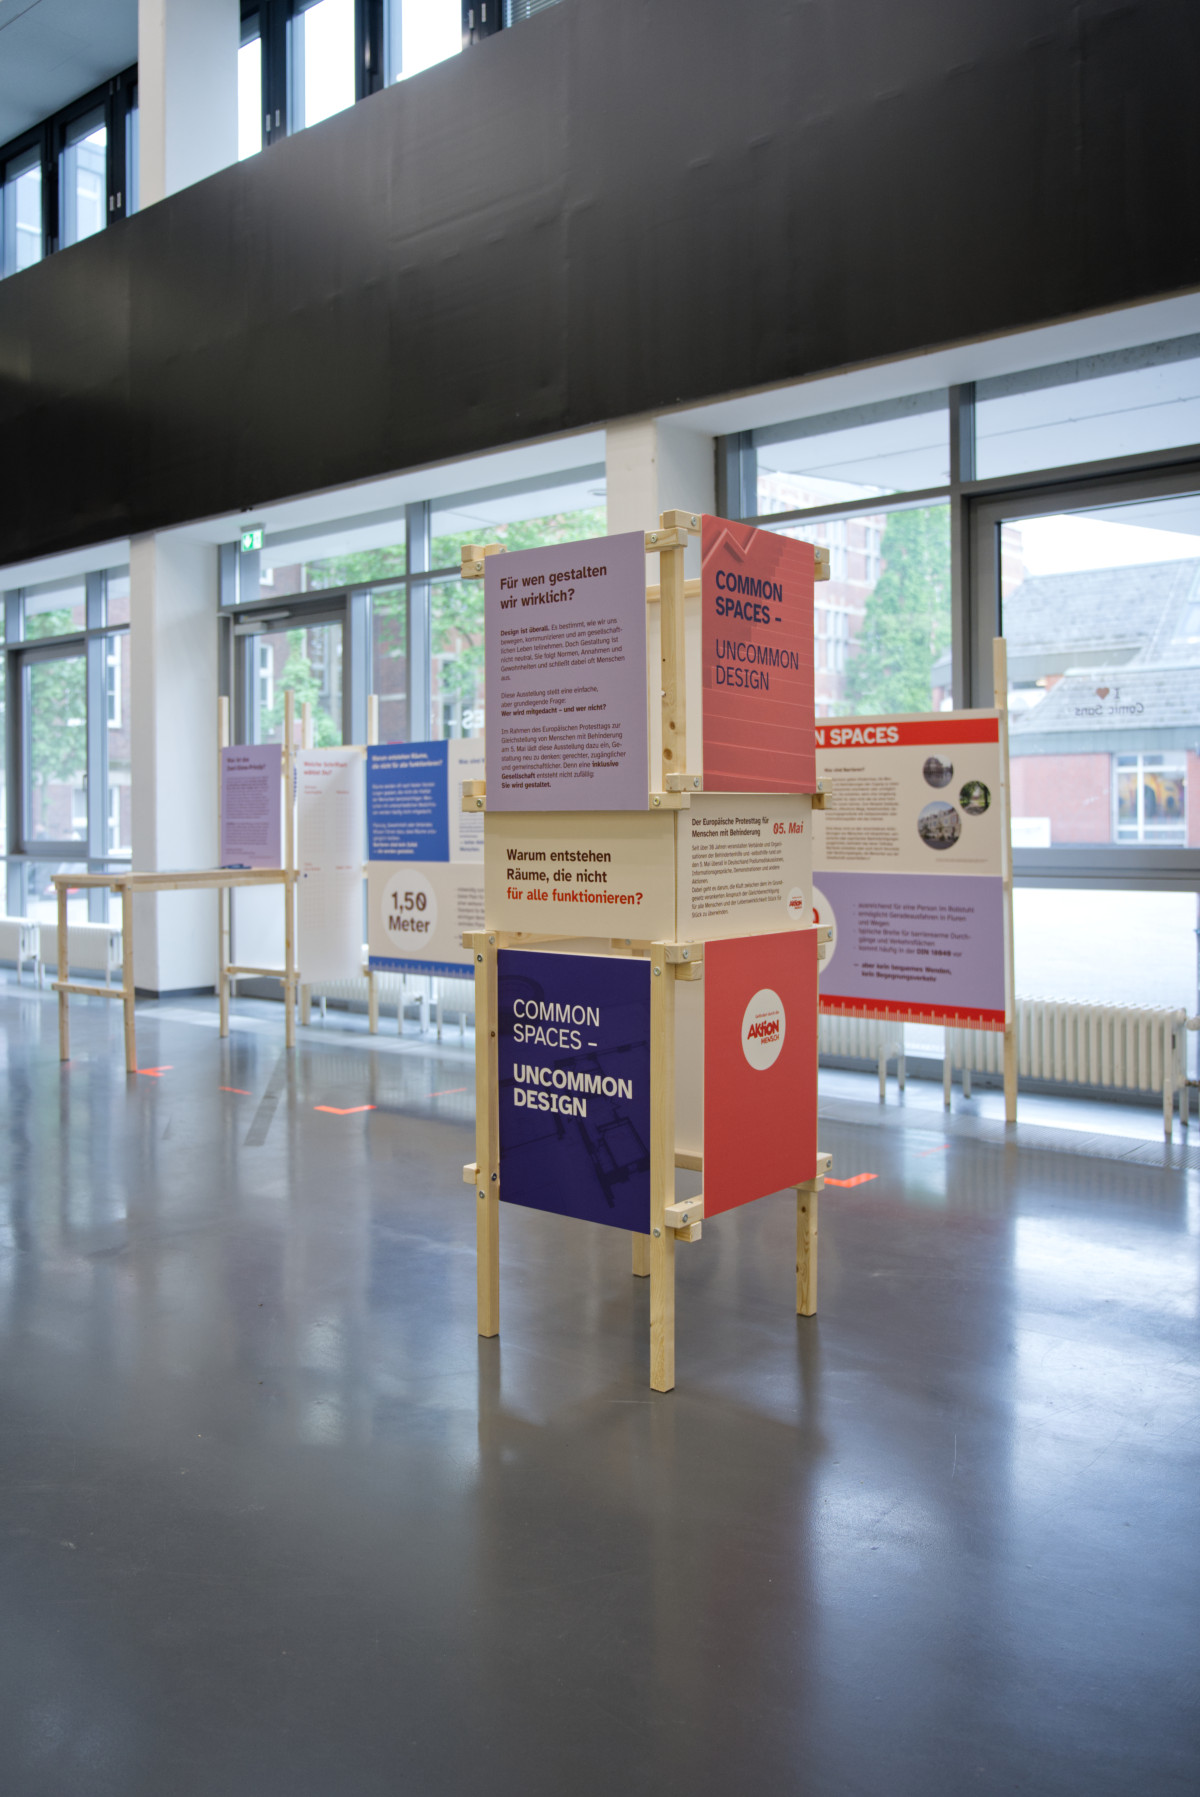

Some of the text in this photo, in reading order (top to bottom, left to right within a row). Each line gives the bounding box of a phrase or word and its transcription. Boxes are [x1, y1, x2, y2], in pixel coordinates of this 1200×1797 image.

[501, 566, 607, 590] Für wen gestalten
[716, 570, 783, 602] COMMON
[501, 588, 575, 609] wir wirklich?
[716, 597, 770, 624] SPACES
[525, 634, 565, 642] kommunizieren
[501, 645, 516, 654] lichen
[716, 639, 799, 670] UNCOMMON
[501, 664, 537, 672] Gewohnheiten
[716, 665, 769, 690] DESIGN
[514, 699, 549, 708] grundlegende
[526, 708, 558, 716] mitgedacht
[830, 726, 899, 745] SPACES
[591, 751, 626, 761] zugänglicher
[512, 763, 562, 771] gemeinschaftlicher.
[703, 817, 734, 826] Europäische
[735, 818, 762, 826] Protesttag
[773, 822, 804, 835] 05. Mai
[730, 828, 761, 837] Behinderung
[507, 849, 611, 862] Warum entstehen
[507, 868, 607, 883] Räume, die nicht
[392, 891, 427, 914] 1,50
[507, 887, 643, 904] für alle funktionieren?
[389, 916, 430, 932] Meter
[514, 998, 600, 1027] COMMON
[513, 1023, 582, 1050] SPACES
[761, 1034, 779, 1045] MENSCH
[514, 1063, 633, 1100] UNCOMMON
[514, 1088, 587, 1118] DESIGN
